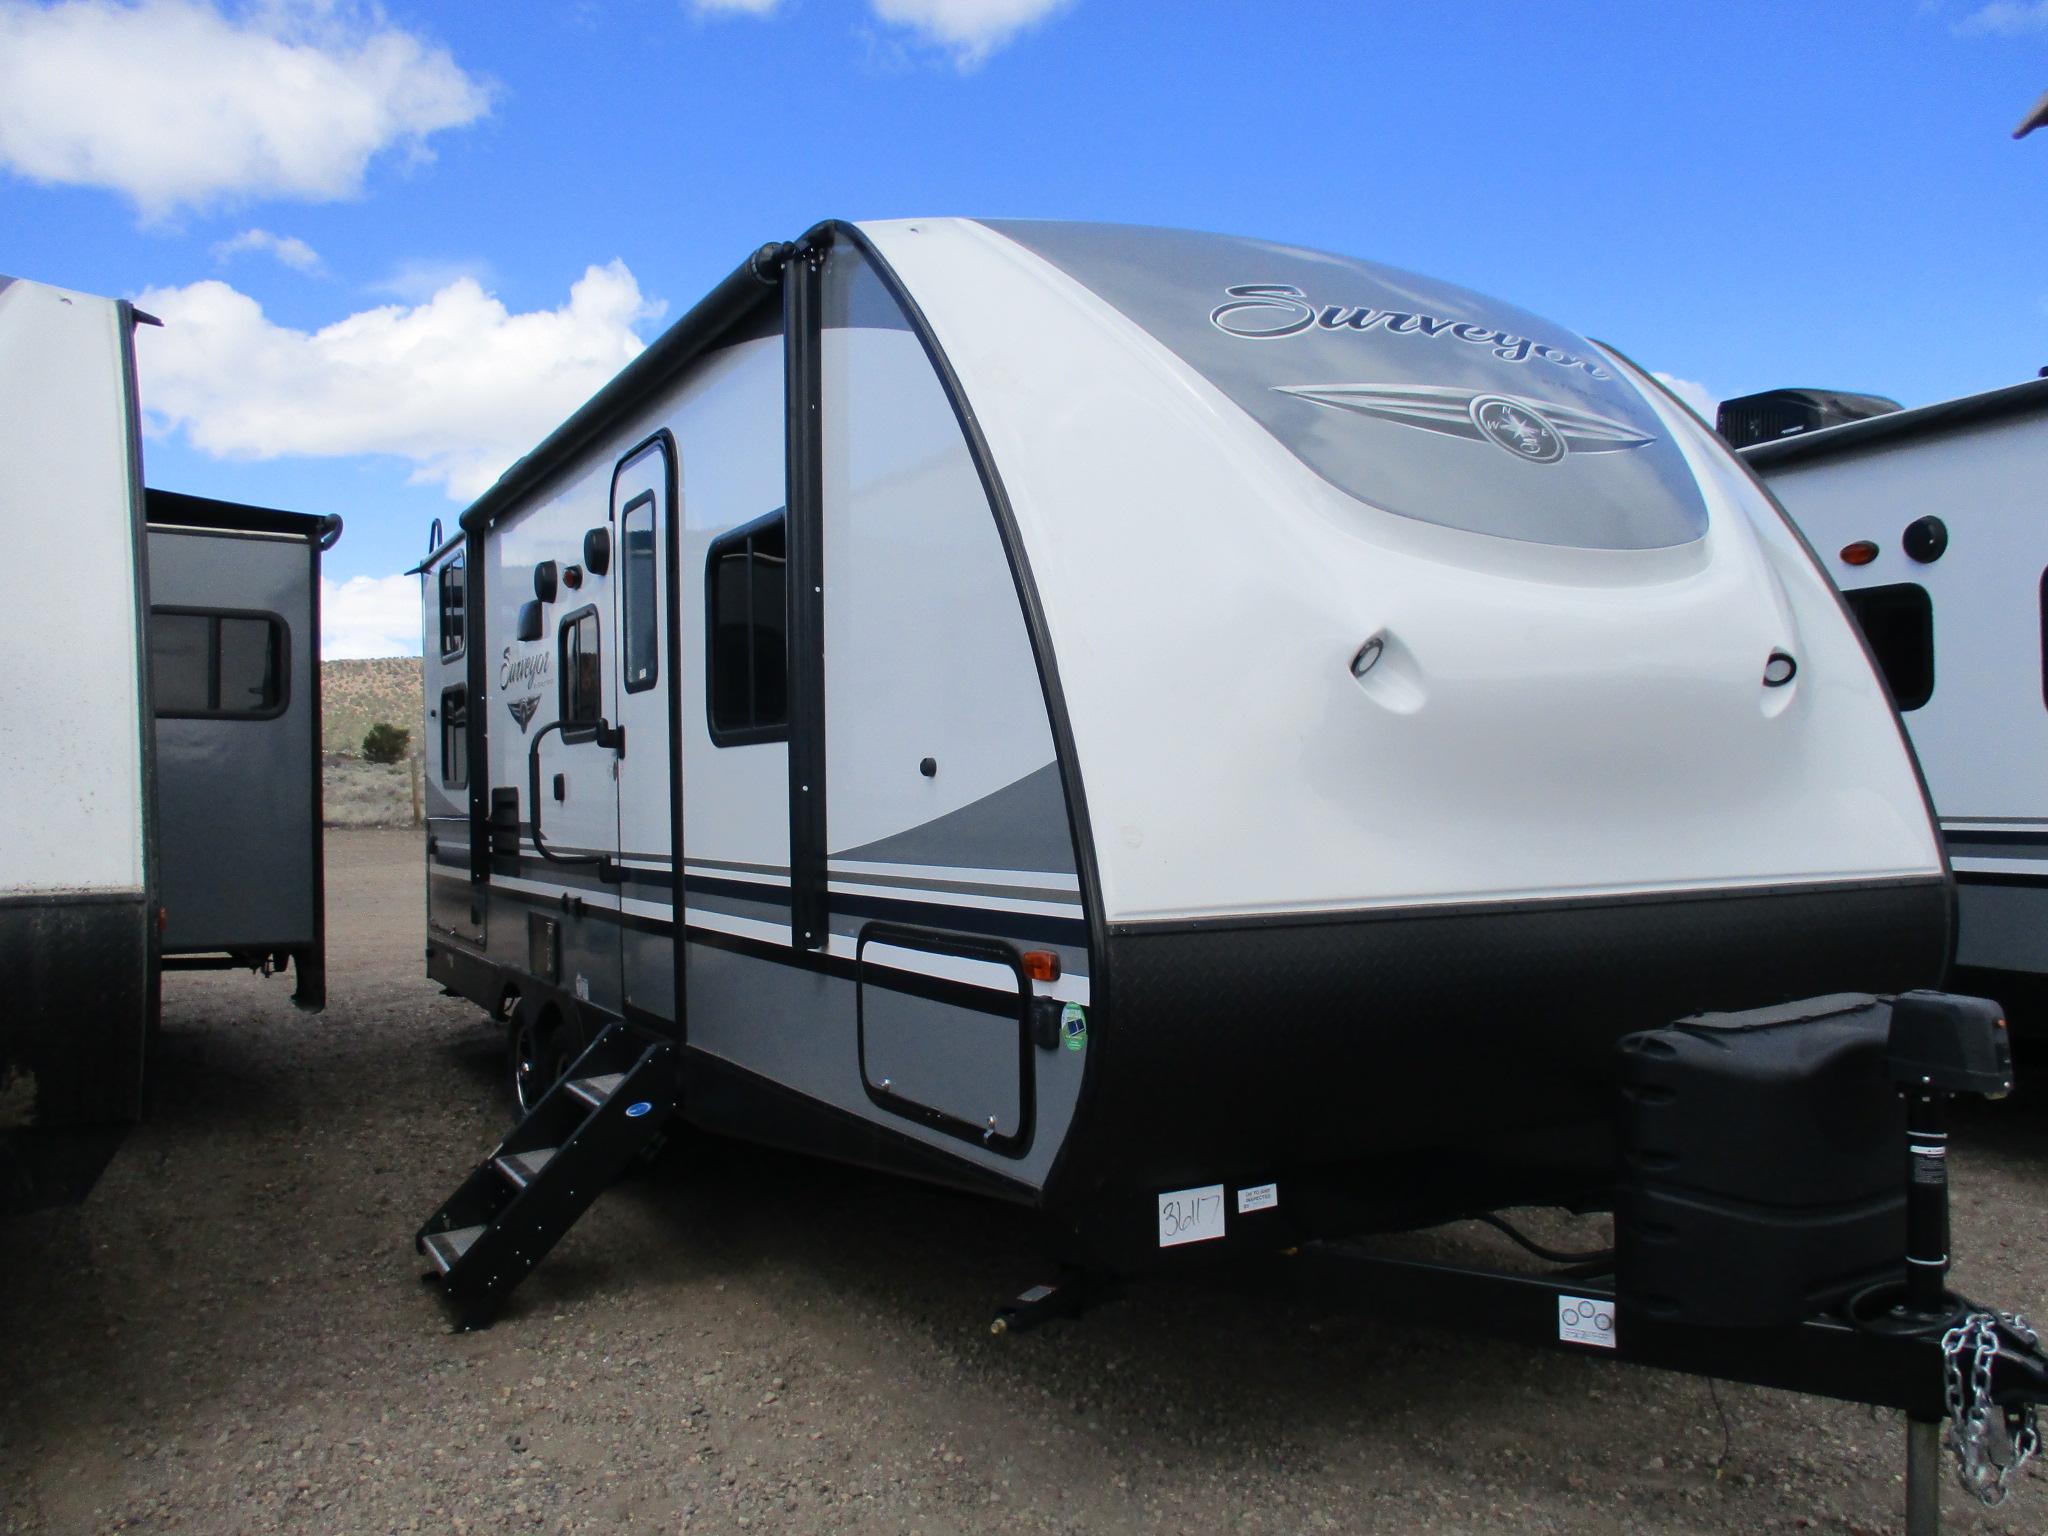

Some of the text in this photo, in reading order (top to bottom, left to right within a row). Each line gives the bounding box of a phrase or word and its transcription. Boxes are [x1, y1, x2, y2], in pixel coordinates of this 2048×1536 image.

[1209, 283, 1611, 380] Surveyor
[1502, 405, 1511, 415] N
[1487, 420, 1500, 430] W
[500, 646, 549, 691] Surveyor
